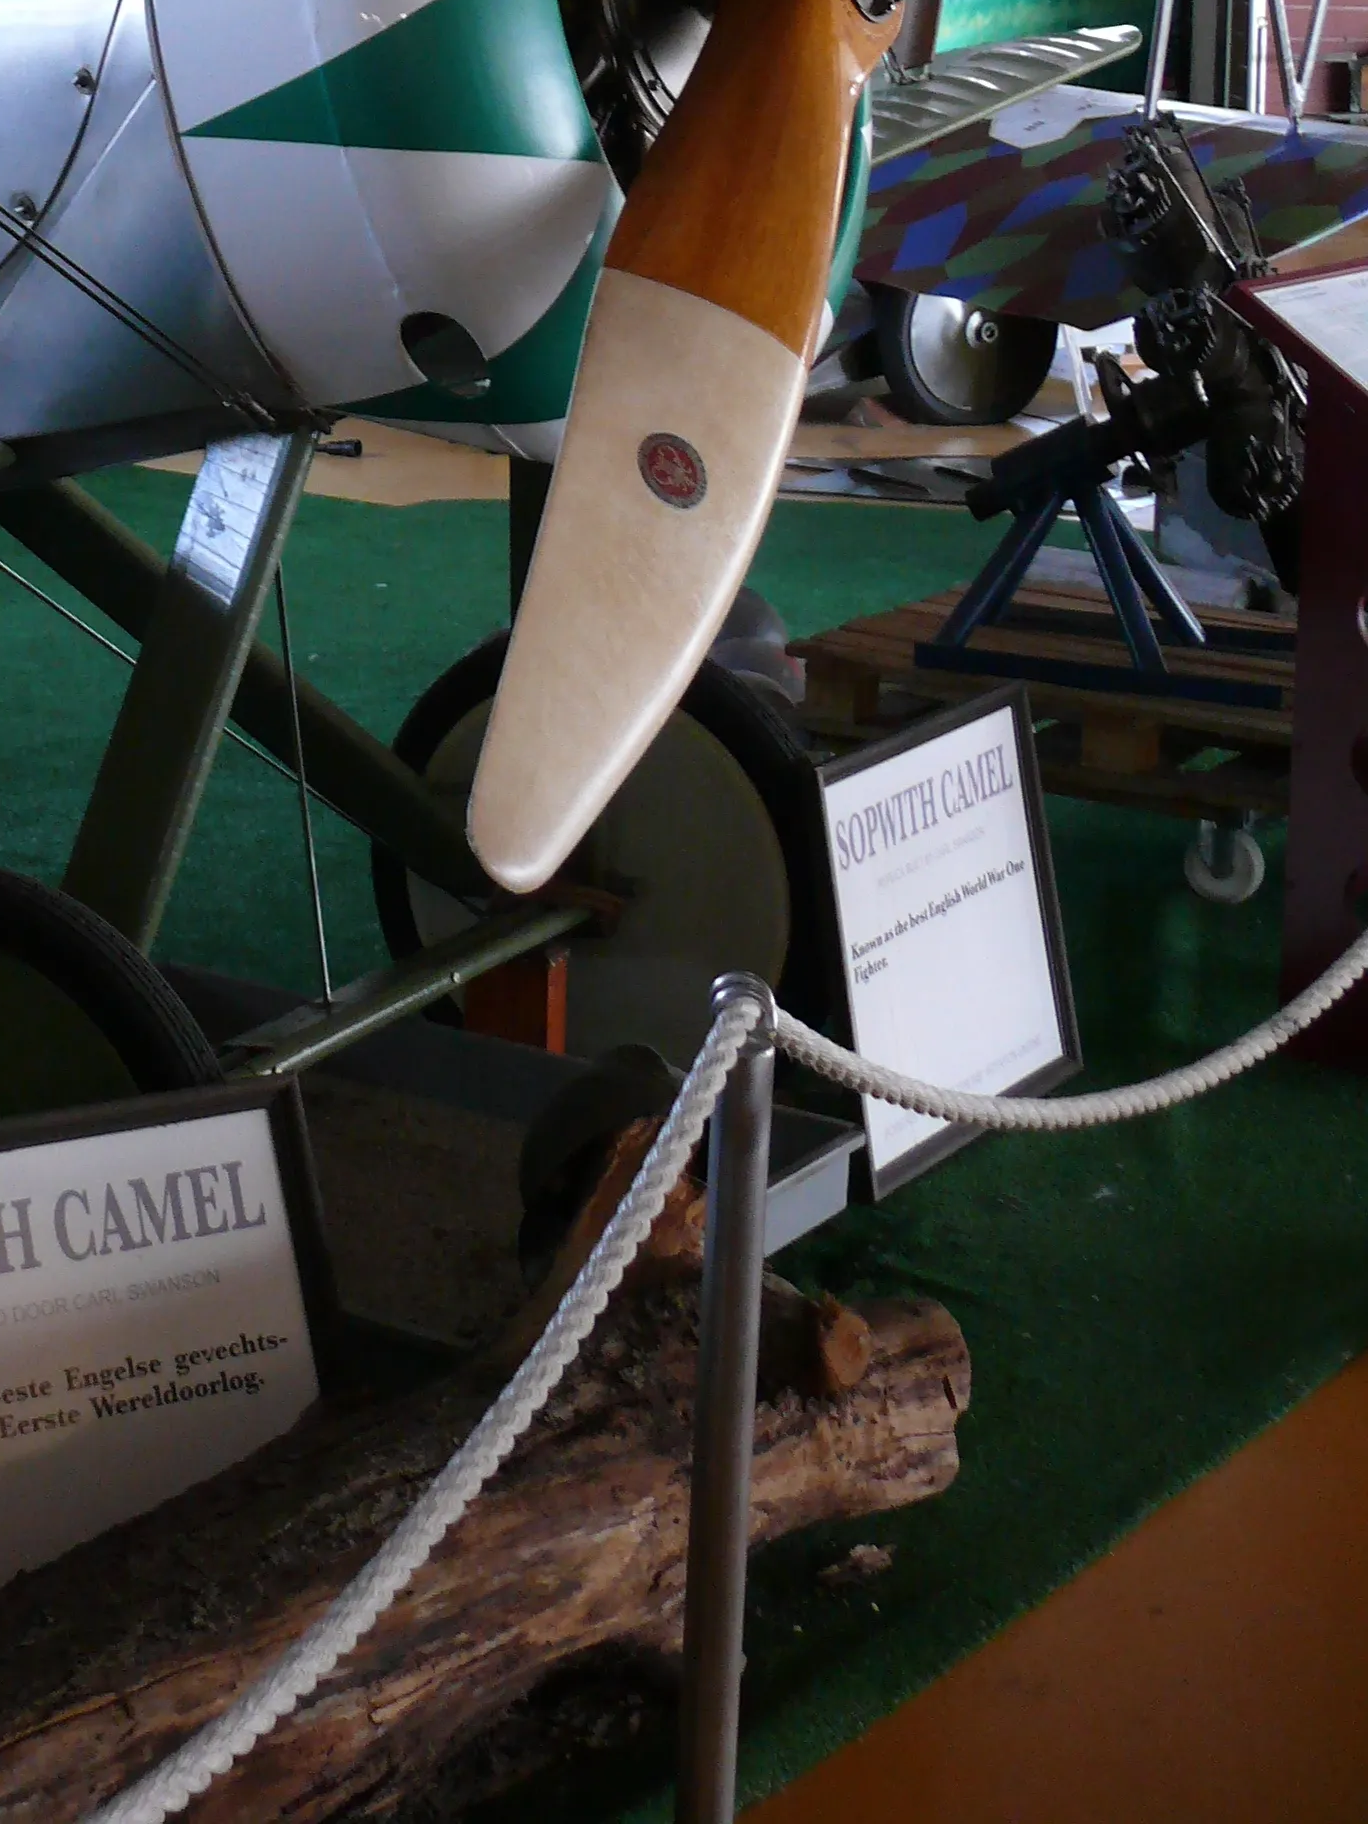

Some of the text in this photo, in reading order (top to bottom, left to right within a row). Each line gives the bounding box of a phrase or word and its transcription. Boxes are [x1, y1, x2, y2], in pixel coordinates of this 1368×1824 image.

[835, 777, 939, 871] SOPWITH
[940, 743, 1014, 818] CAMEL
[851, 859, 1025, 961] Known as the best English World War One
[853, 957, 889, 984] Fighter.
[52, 1160, 267, 1262] CAMEL
[12, 1296, 69, 1324] DOOR
[72, 1285, 123, 1312] CARL
[128, 1268, 222, 1302] SWANSON
[63, 1355, 163, 1392] Engelse
[174, 1332, 289, 1376] gevechts-
[88, 1370, 266, 1419] Wereldoorlog.
